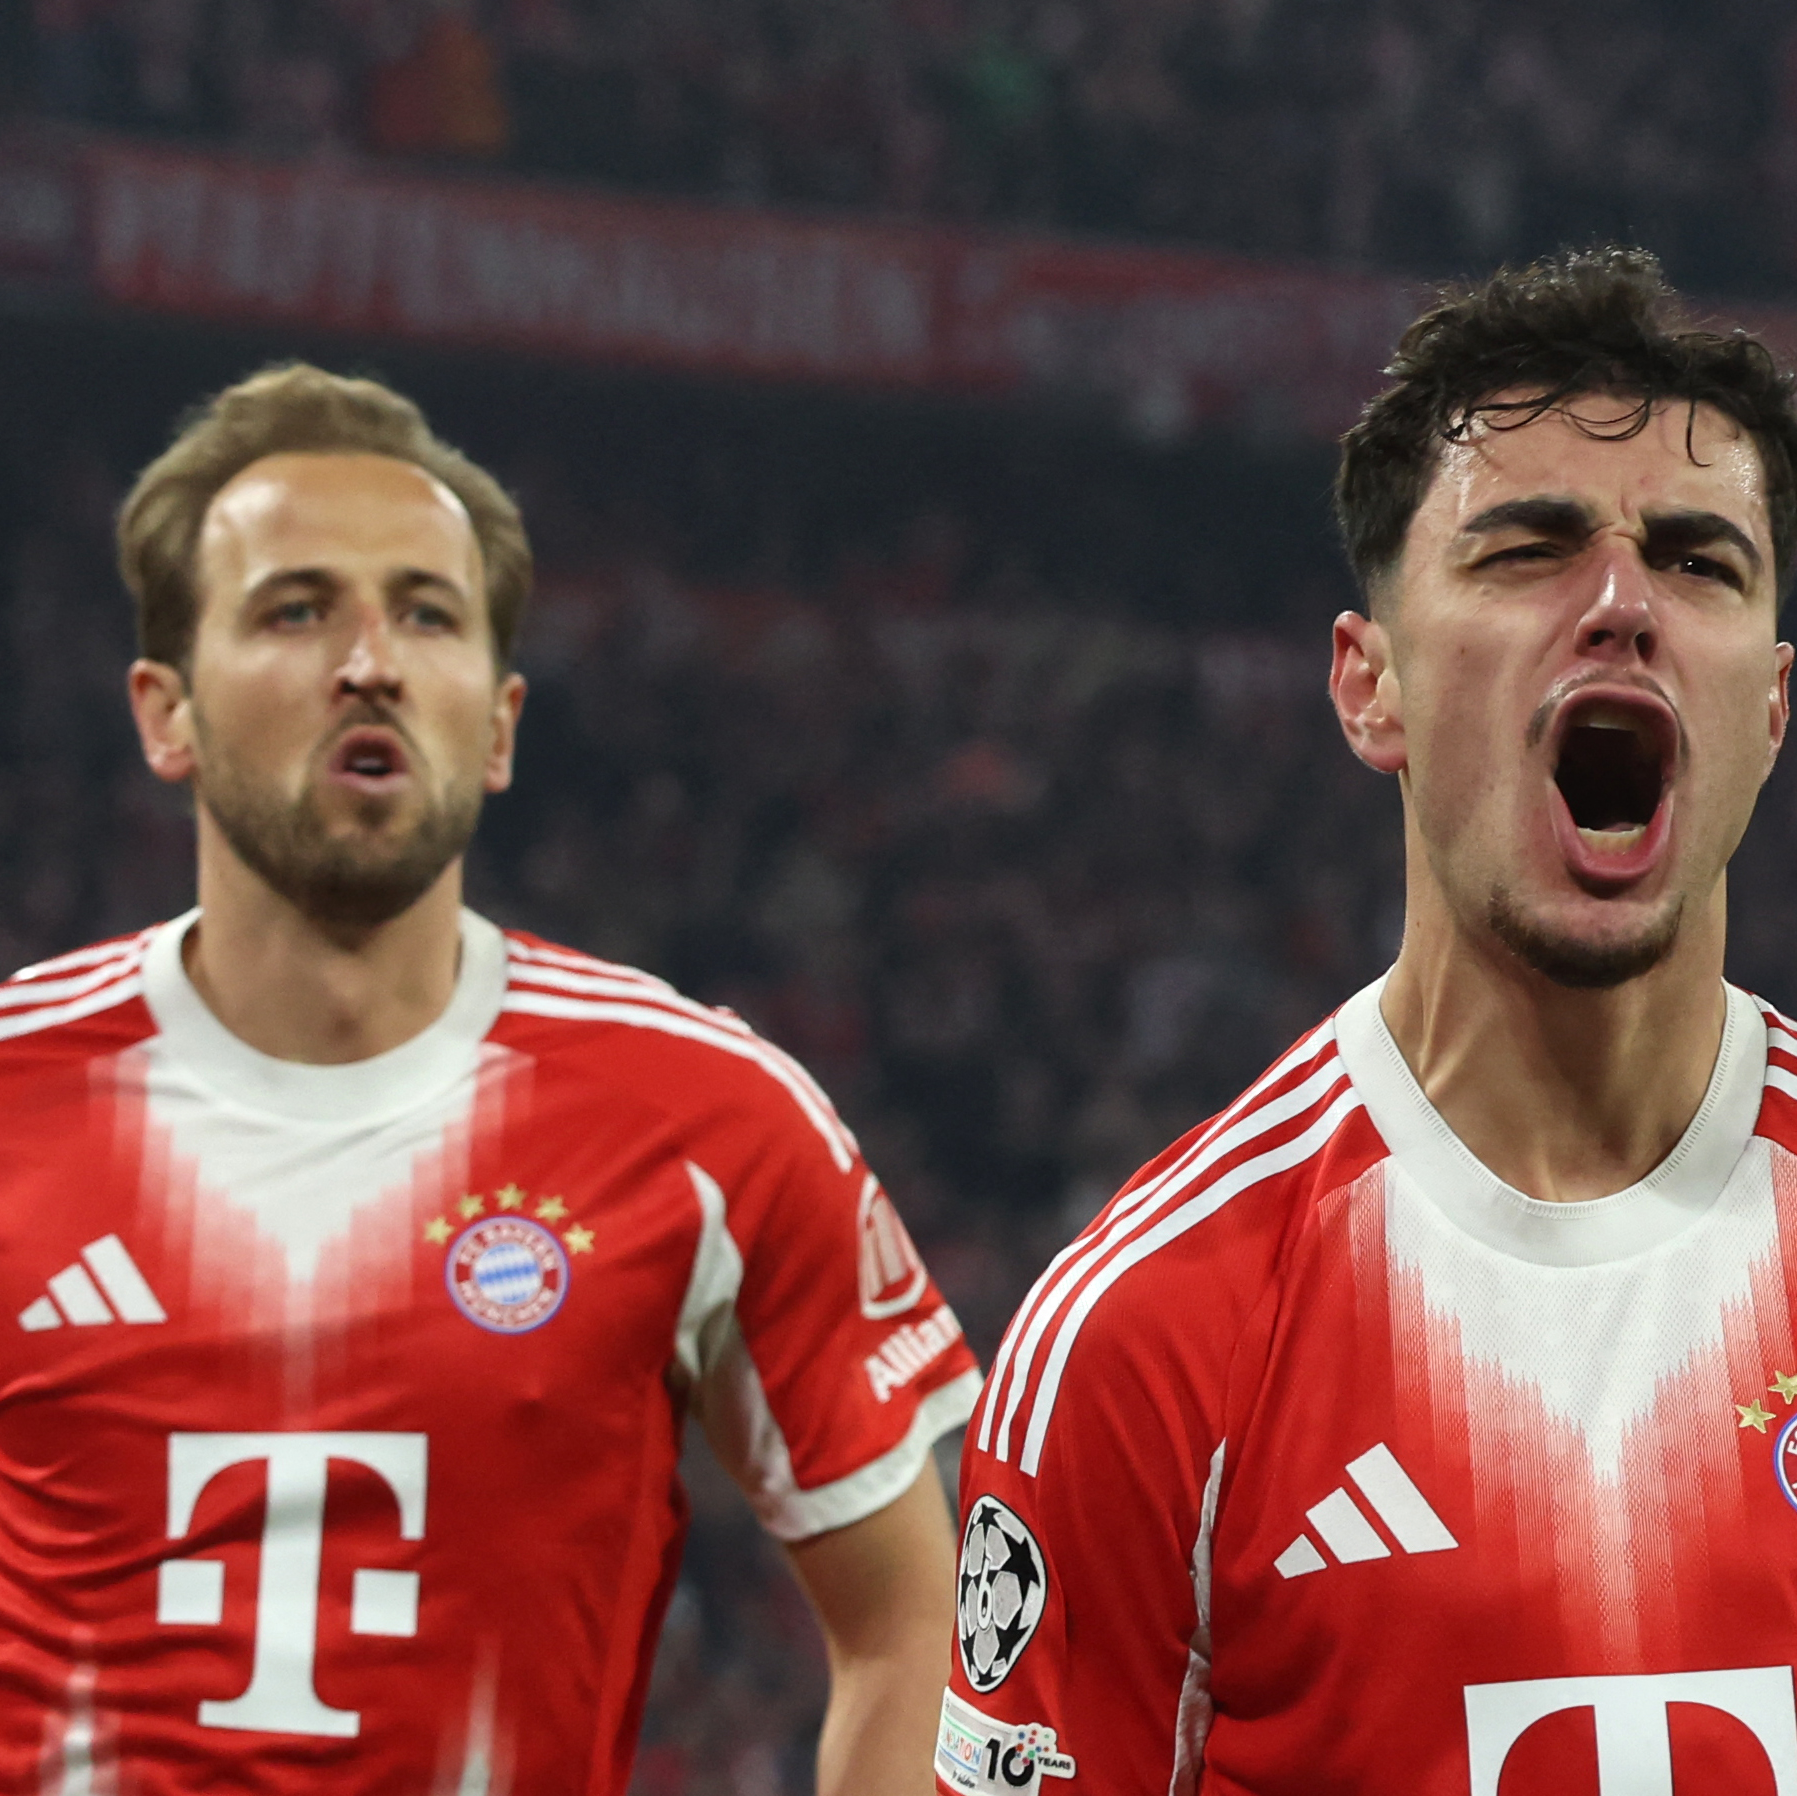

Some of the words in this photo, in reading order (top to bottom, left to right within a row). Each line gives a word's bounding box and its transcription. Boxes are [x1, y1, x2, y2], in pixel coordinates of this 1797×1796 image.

[157, 1431, 428, 1738] T
[985, 1737, 1035, 1788] 10
[1037, 1756, 1071, 1770] YEARS
